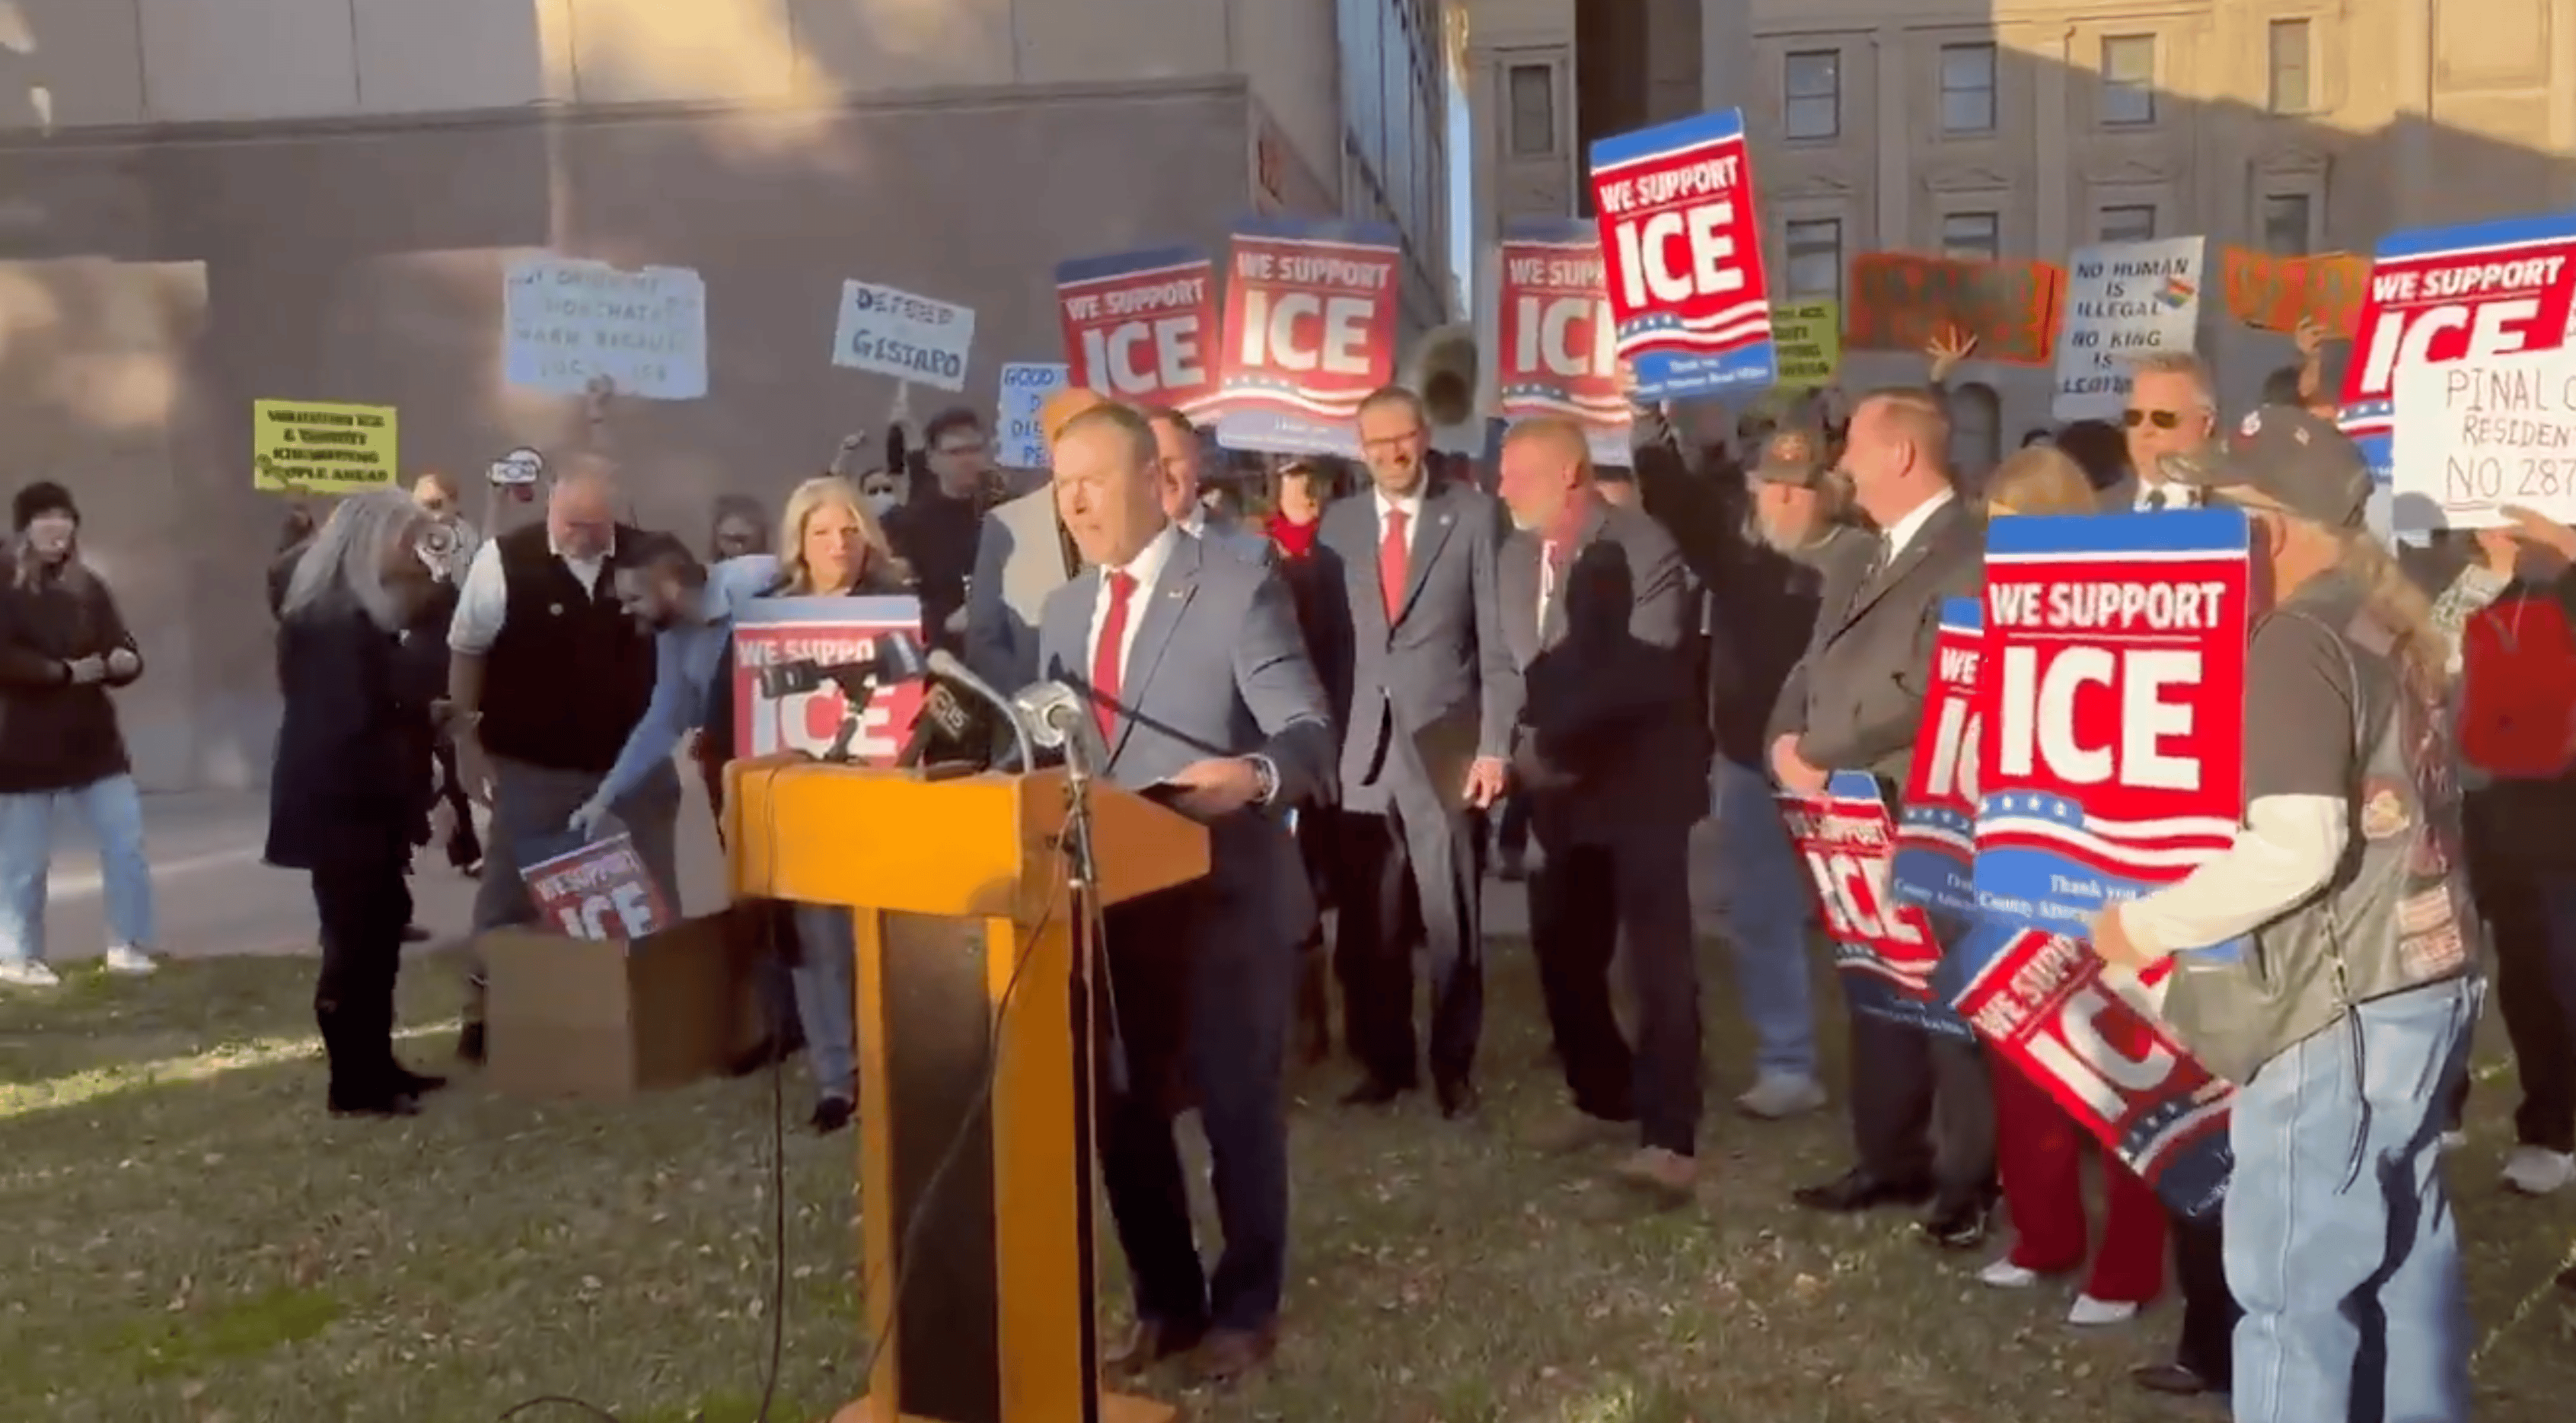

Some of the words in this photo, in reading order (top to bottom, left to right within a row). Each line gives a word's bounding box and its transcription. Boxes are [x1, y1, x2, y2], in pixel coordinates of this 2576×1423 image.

[1599, 181, 1634, 213] WE
[1637, 155, 1739, 207] SUPPORT
[1236, 252, 1274, 279] WE
[1278, 253, 1392, 288] SUPPORT
[1510, 258, 1545, 285] WE
[1614, 200, 1745, 309] ICE
[2076, 262, 2104, 279] NO
[2112, 257, 2189, 277] HUMAN
[1066, 295, 1101, 321] WE
[1104, 277, 1206, 317] SUPPORT
[2106, 281, 2125, 298] IS
[2372, 272, 2418, 303] WE
[2421, 255, 2566, 297] SUPPORT
[1241, 289, 1375, 374] ICE
[2077, 301, 2162, 318] ILLEGAL
[1082, 315, 1207, 398] ICE
[2071, 329, 2099, 348] NO
[2109, 329, 2162, 349] KING
[2446, 367, 2549, 412] PINAL
[2462, 414, 2576, 449] RESIDEN
[2446, 454, 2503, 498] NO
[1988, 581, 2048, 627] WE
[2048, 581, 2225, 630] SUPPORT
[738, 639, 778, 667] WE
[1940, 646, 1980, 684] WE
[751, 673, 898, 760] ICE
[1999, 645, 2202, 791] ICE
[1970, 991, 2028, 1042] WE
[2024, 974, 2177, 1124] IC
